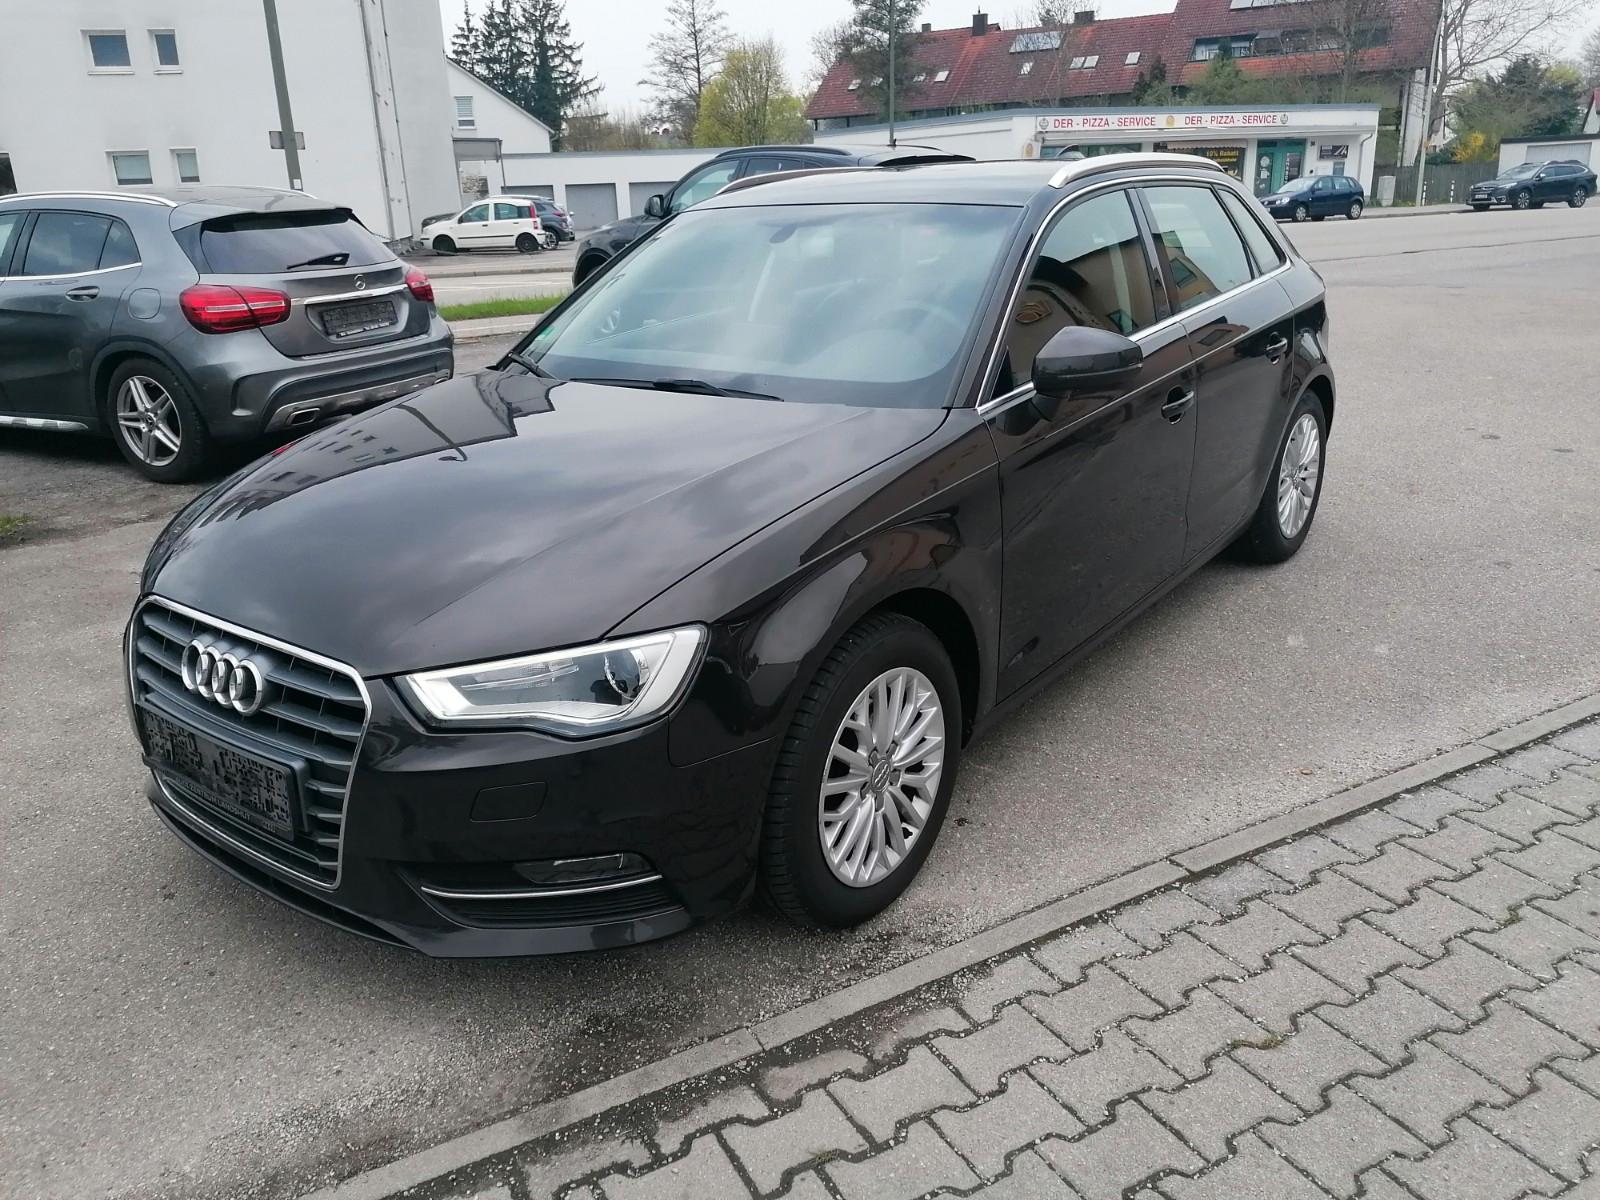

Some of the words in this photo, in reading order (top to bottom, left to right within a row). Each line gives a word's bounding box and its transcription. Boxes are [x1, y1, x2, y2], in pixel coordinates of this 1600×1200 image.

[1053, 118, 1073, 128] DER
[1082, 118, 1110, 128] PIZZA
[1117, 117, 1156, 127] SERVICE
[1185, 115, 1202, 125] DER
[1210, 115, 1235, 125] PIZZA
[1242, 114, 1277, 124] SERVICE
